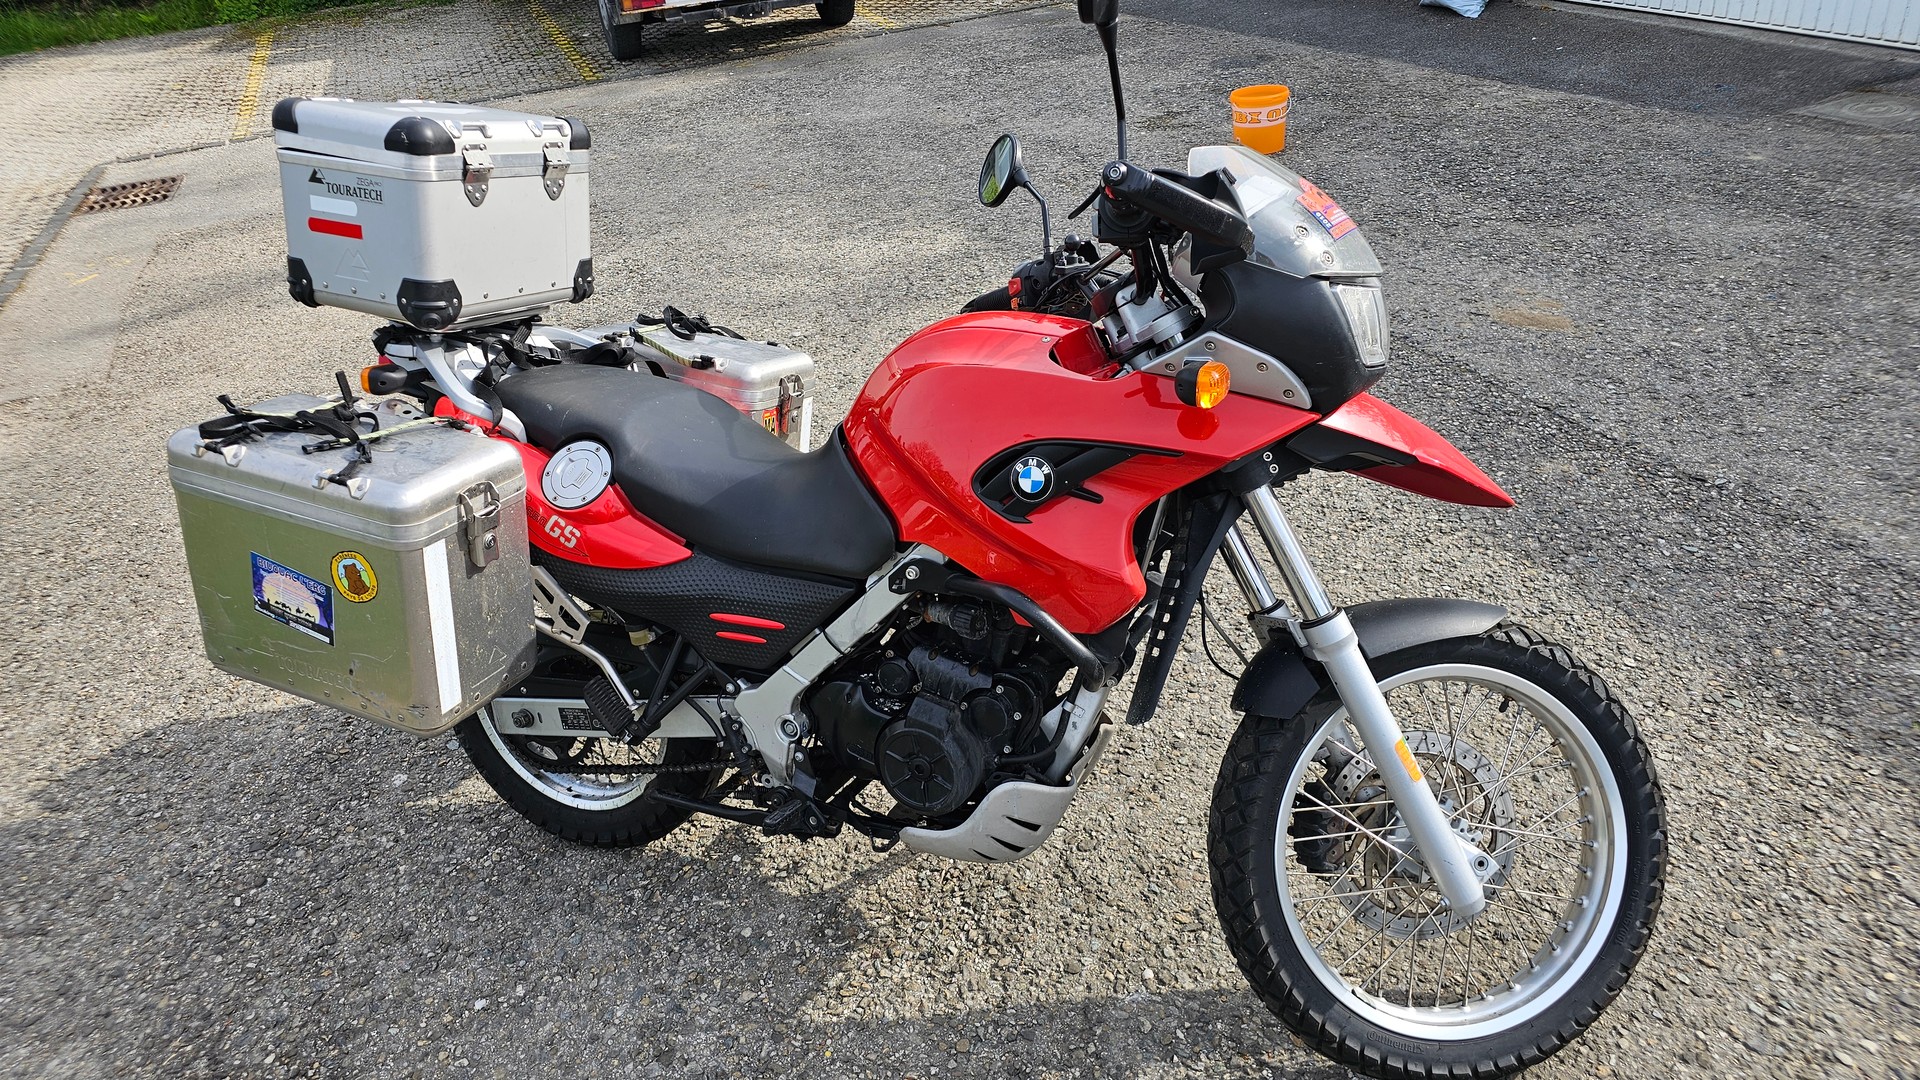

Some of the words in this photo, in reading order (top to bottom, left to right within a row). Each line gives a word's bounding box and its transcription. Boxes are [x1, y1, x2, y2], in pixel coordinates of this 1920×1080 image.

[356, 177, 374, 187] ZEGA
[325, 182, 383, 201] TOURATECH
[1015, 458, 1050, 475] BMW
[545, 515, 581, 548] GS
